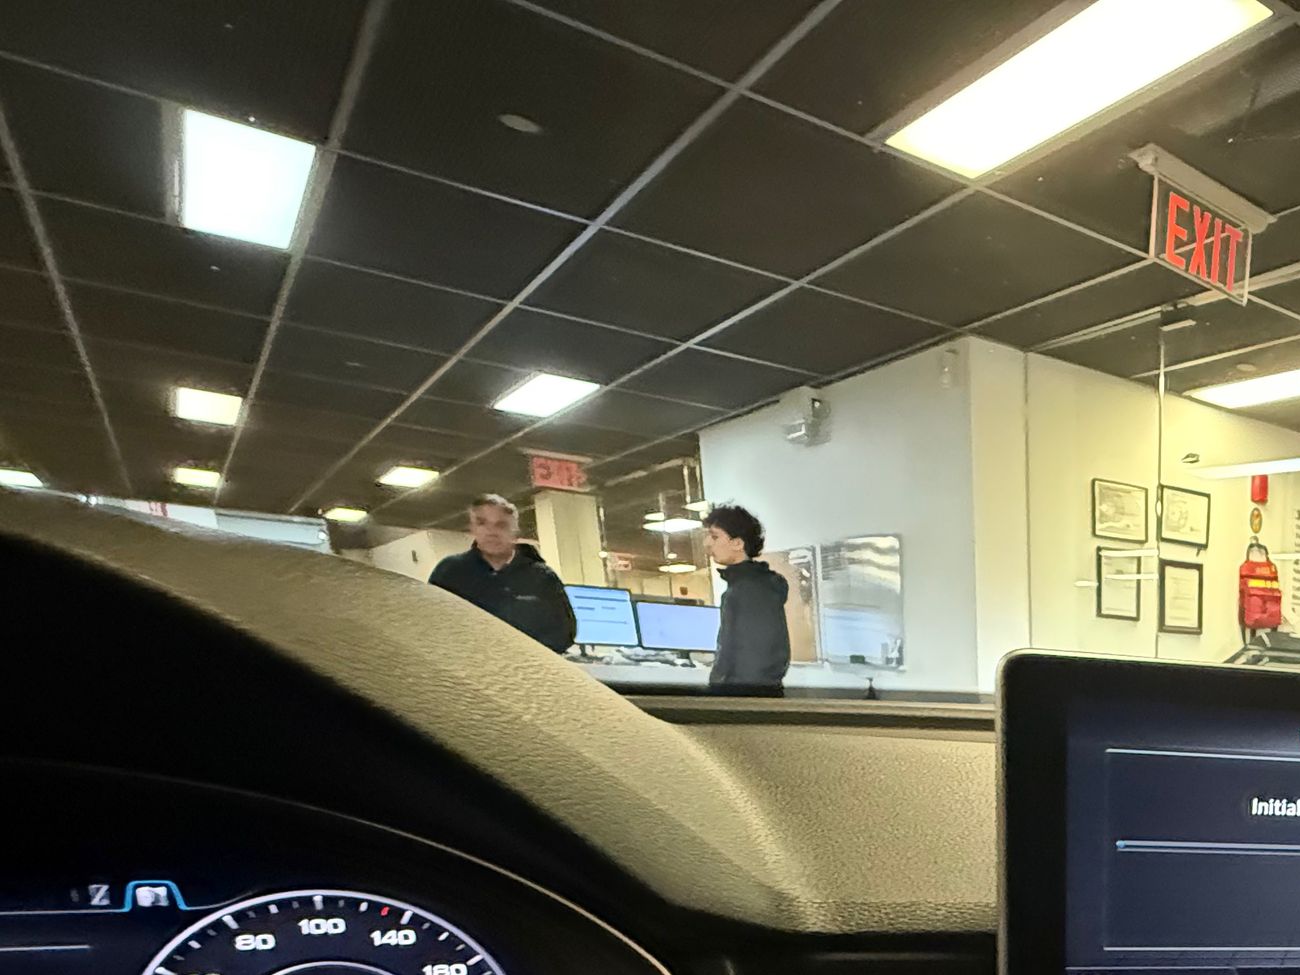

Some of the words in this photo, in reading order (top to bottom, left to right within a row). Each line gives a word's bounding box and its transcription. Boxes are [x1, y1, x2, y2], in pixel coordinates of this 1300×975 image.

[1165, 191, 1244, 292] EXIT
[298, 918, 347, 935] 100
[235, 934, 276, 951] 80
[370, 929, 417, 946] 140
